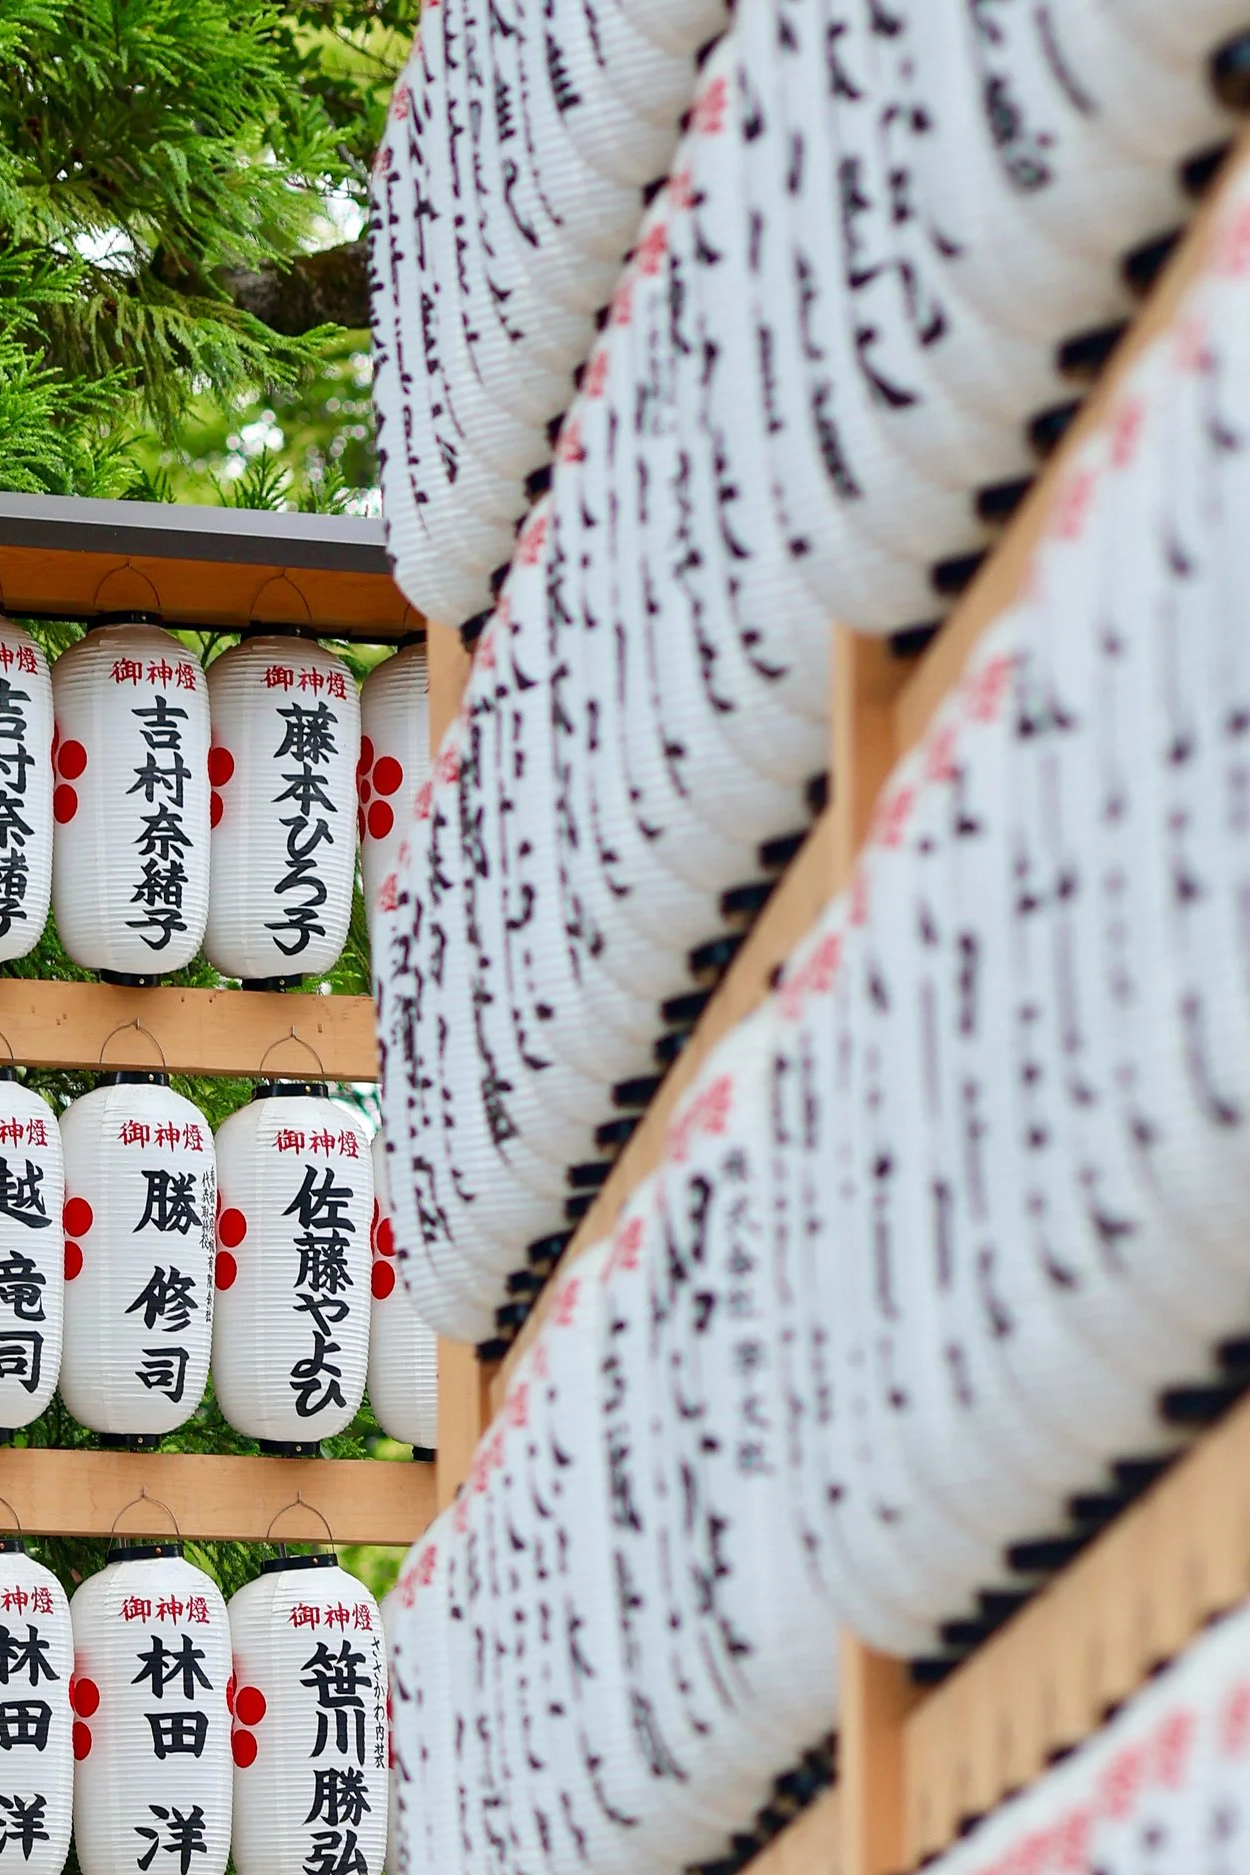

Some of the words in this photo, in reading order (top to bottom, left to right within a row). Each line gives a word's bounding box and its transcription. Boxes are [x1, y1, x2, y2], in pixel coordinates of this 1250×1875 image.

[110, 657, 195, 690] 御神燈
[265, 665, 347, 700] 御神燈
[125, 695, 193, 950] 吉村奈緒子
[264, 702, 341, 958] 藤本ひろ子
[121, 1120, 202, 1151] 御神燈
[276, 1129, 358, 1158] 御神燈
[125, 1170, 200, 1404] 勝修司
[282, 1165, 358, 1419] 佐藤やよひ
[122, 1595, 208, 1623] 御神燈
[290, 1603, 371, 1630] 御神燈
